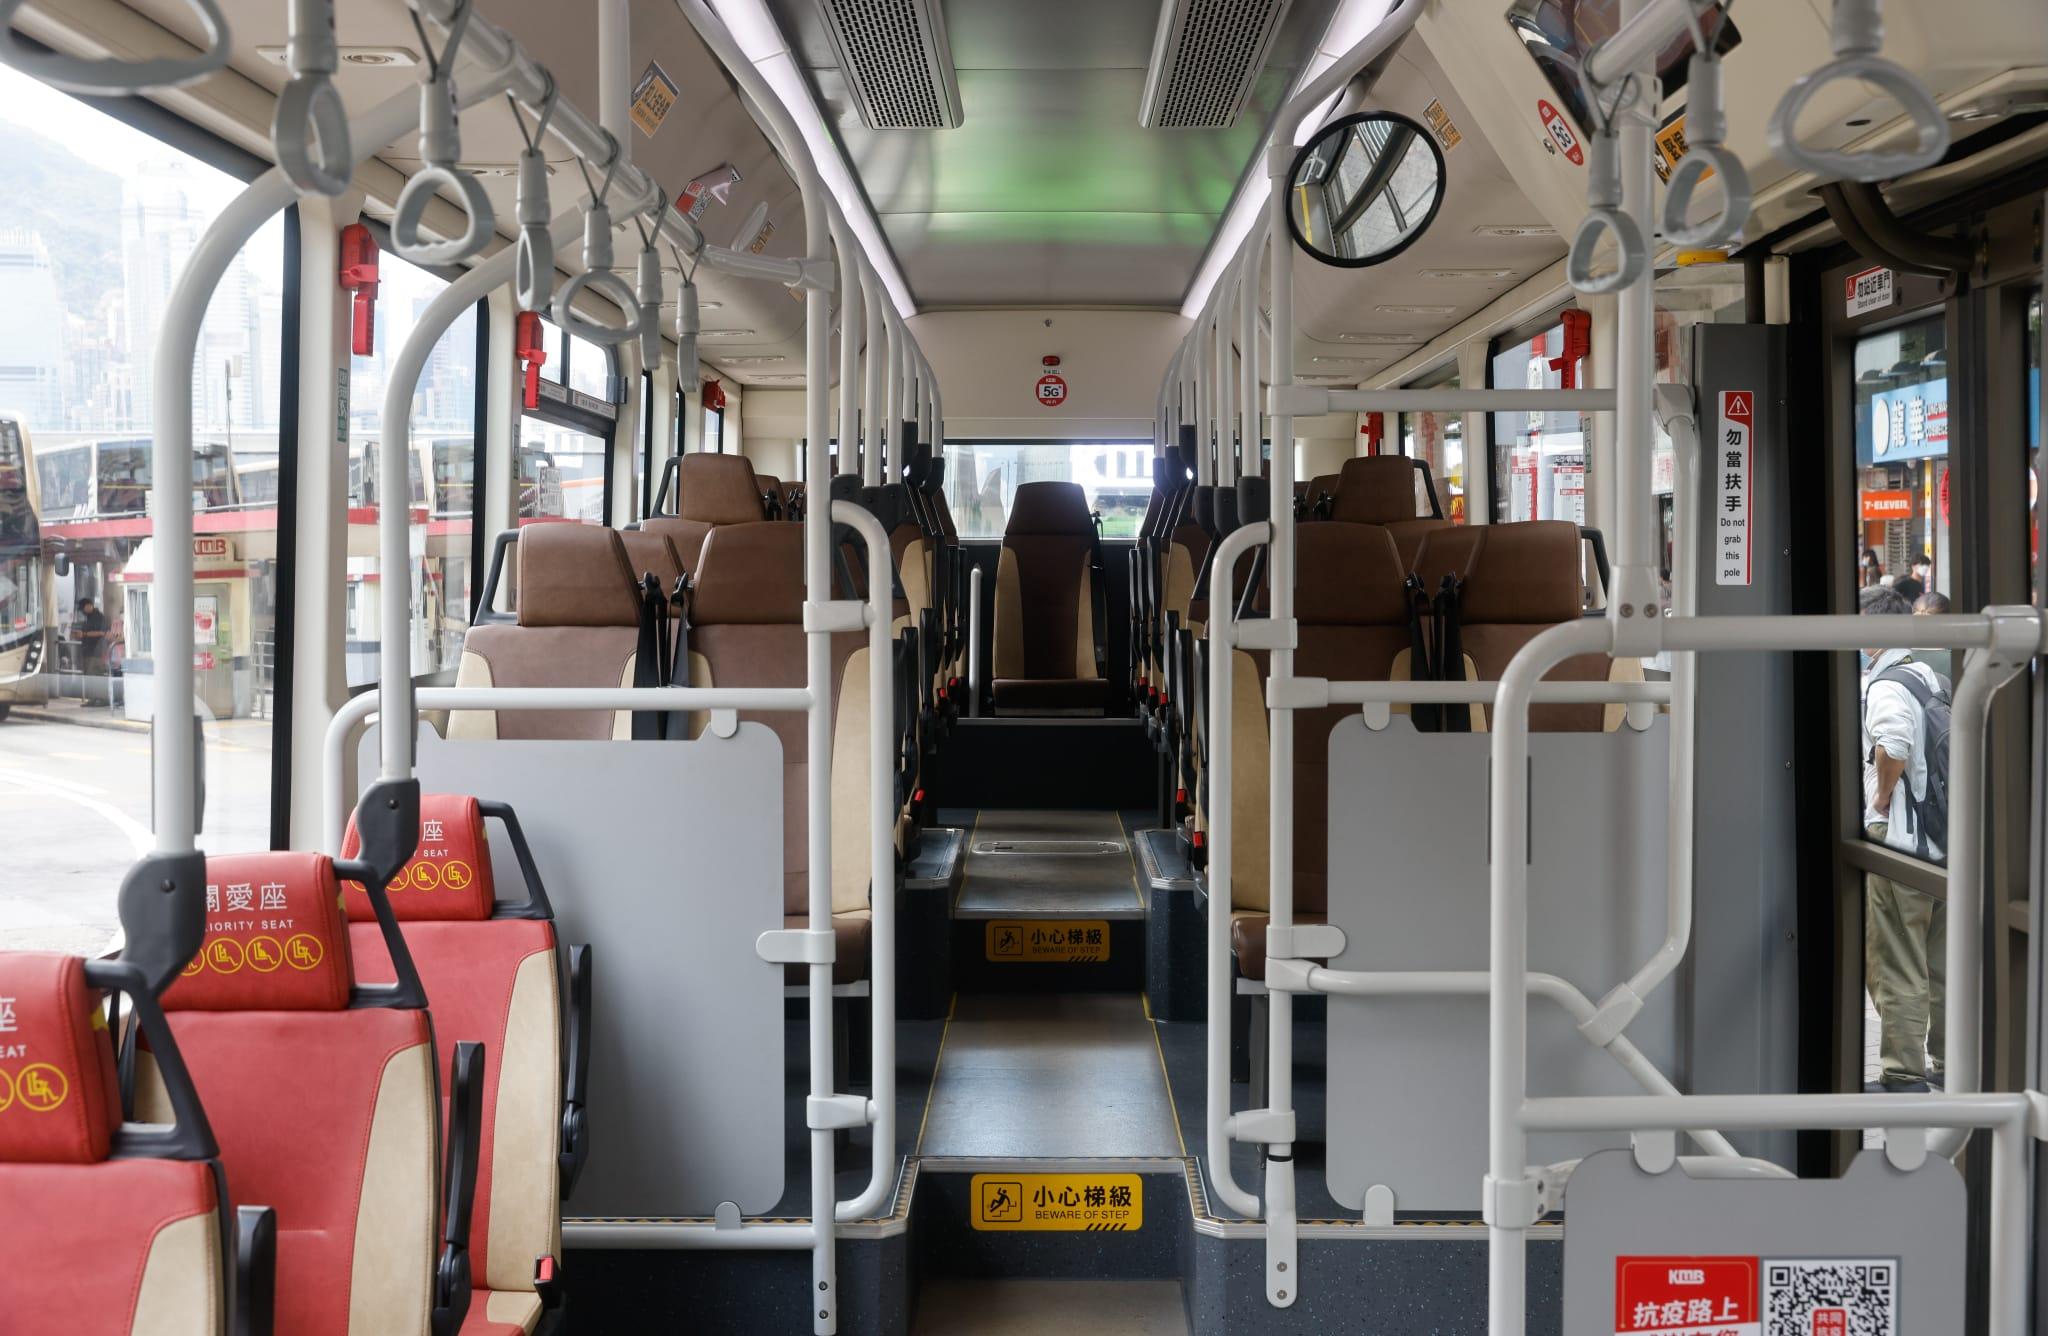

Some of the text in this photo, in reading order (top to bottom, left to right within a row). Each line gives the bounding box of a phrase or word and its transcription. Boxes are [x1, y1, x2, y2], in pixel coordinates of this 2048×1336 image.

[1857, 271, 1891, 298] 勿站近車門
[1891, 396, 1926, 448] 龍華
[1725, 429, 1742, 512] 勿當扶手
[1720, 518, 1745, 527] Do not
[1724, 535, 1741, 545] grab
[1725, 551, 1740, 560] this
[1724, 568, 1740, 579] pole
[422, 818, 444, 841] 座
[424, 849, 448, 857] SEAT
[206, 919, 293, 932] IORITY SEAT
[1031, 928, 1103, 945] 小心梯級
[1033, 1185, 1132, 1208] 小心梯級
[1035, 1210, 1130, 1220] BEWARE OF STEP
[1668, 1269, 1705, 1285] KMB
[1633, 1296, 1740, 1328] 抗疫路上
